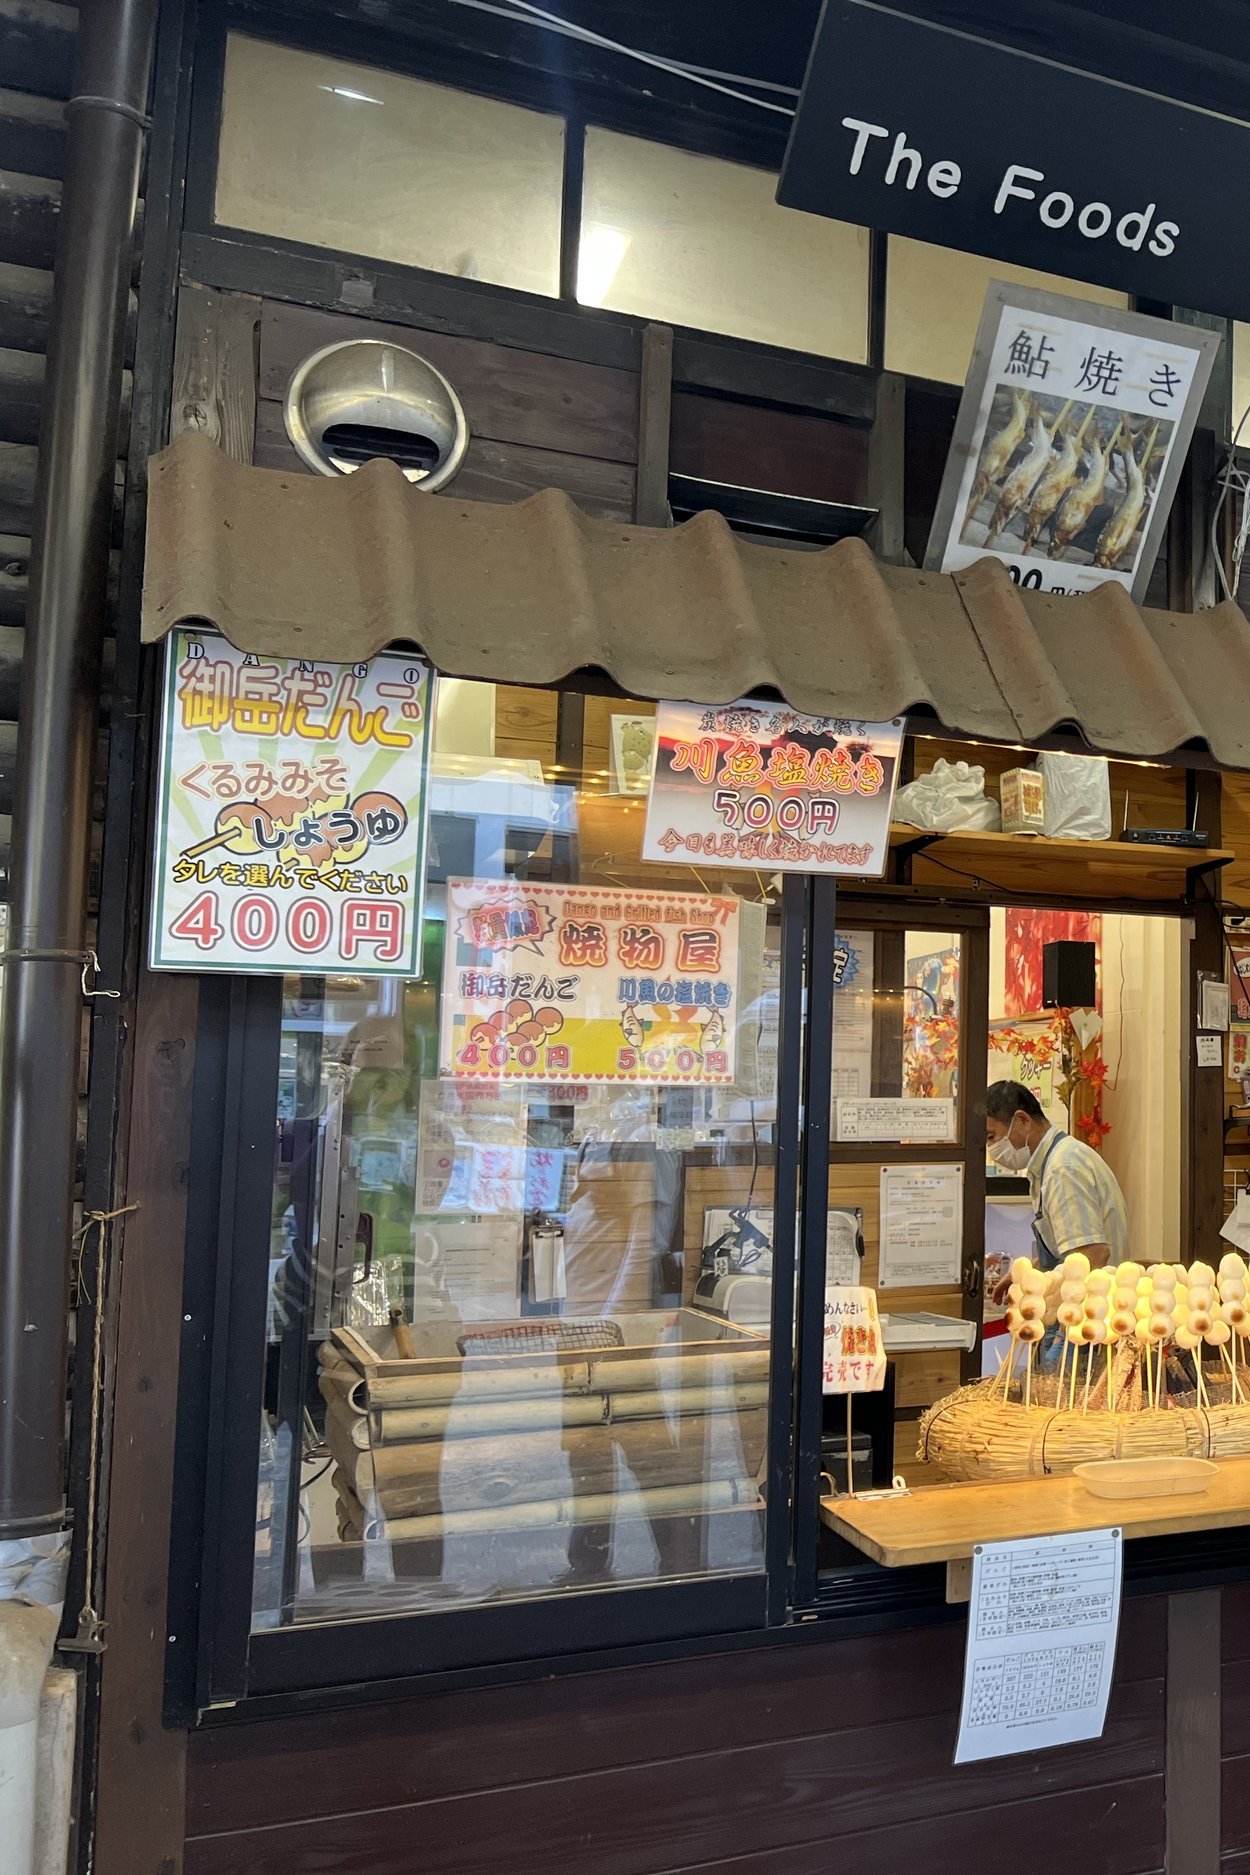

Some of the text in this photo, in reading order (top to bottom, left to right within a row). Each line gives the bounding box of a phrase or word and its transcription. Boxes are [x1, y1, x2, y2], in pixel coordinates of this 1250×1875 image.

[840, 116, 962, 199] The
[993, 165, 1181, 258] Foods
[1004, 329, 1184, 407] 鮎焼き
[178, 657, 421, 749] 御岳だんご
[698, 711, 868, 736] 炭焼き名人が焼く
[178, 756, 349, 800] くるみみそ
[670, 737, 884, 796] 川魚塩焼き
[252, 807, 404, 850] しょうゆ
[712, 789, 840, 835] 500円
[658, 828, 873, 866] 今日も美味しく焼かれてます
[173, 859, 409, 895] タレを選んでください
[168, 889, 406, 963] 400円
[600, 903, 623, 920] and
[624, 903, 661, 922] Grilled
[559, 920, 721, 972] 焼物屋
[459, 970, 580, 1001] 御岳だんご
[617, 976, 732, 1008] 川魚の塩焼き
[457, 1041, 572, 1070] 400円
[616, 1046, 729, 1074] 500円
